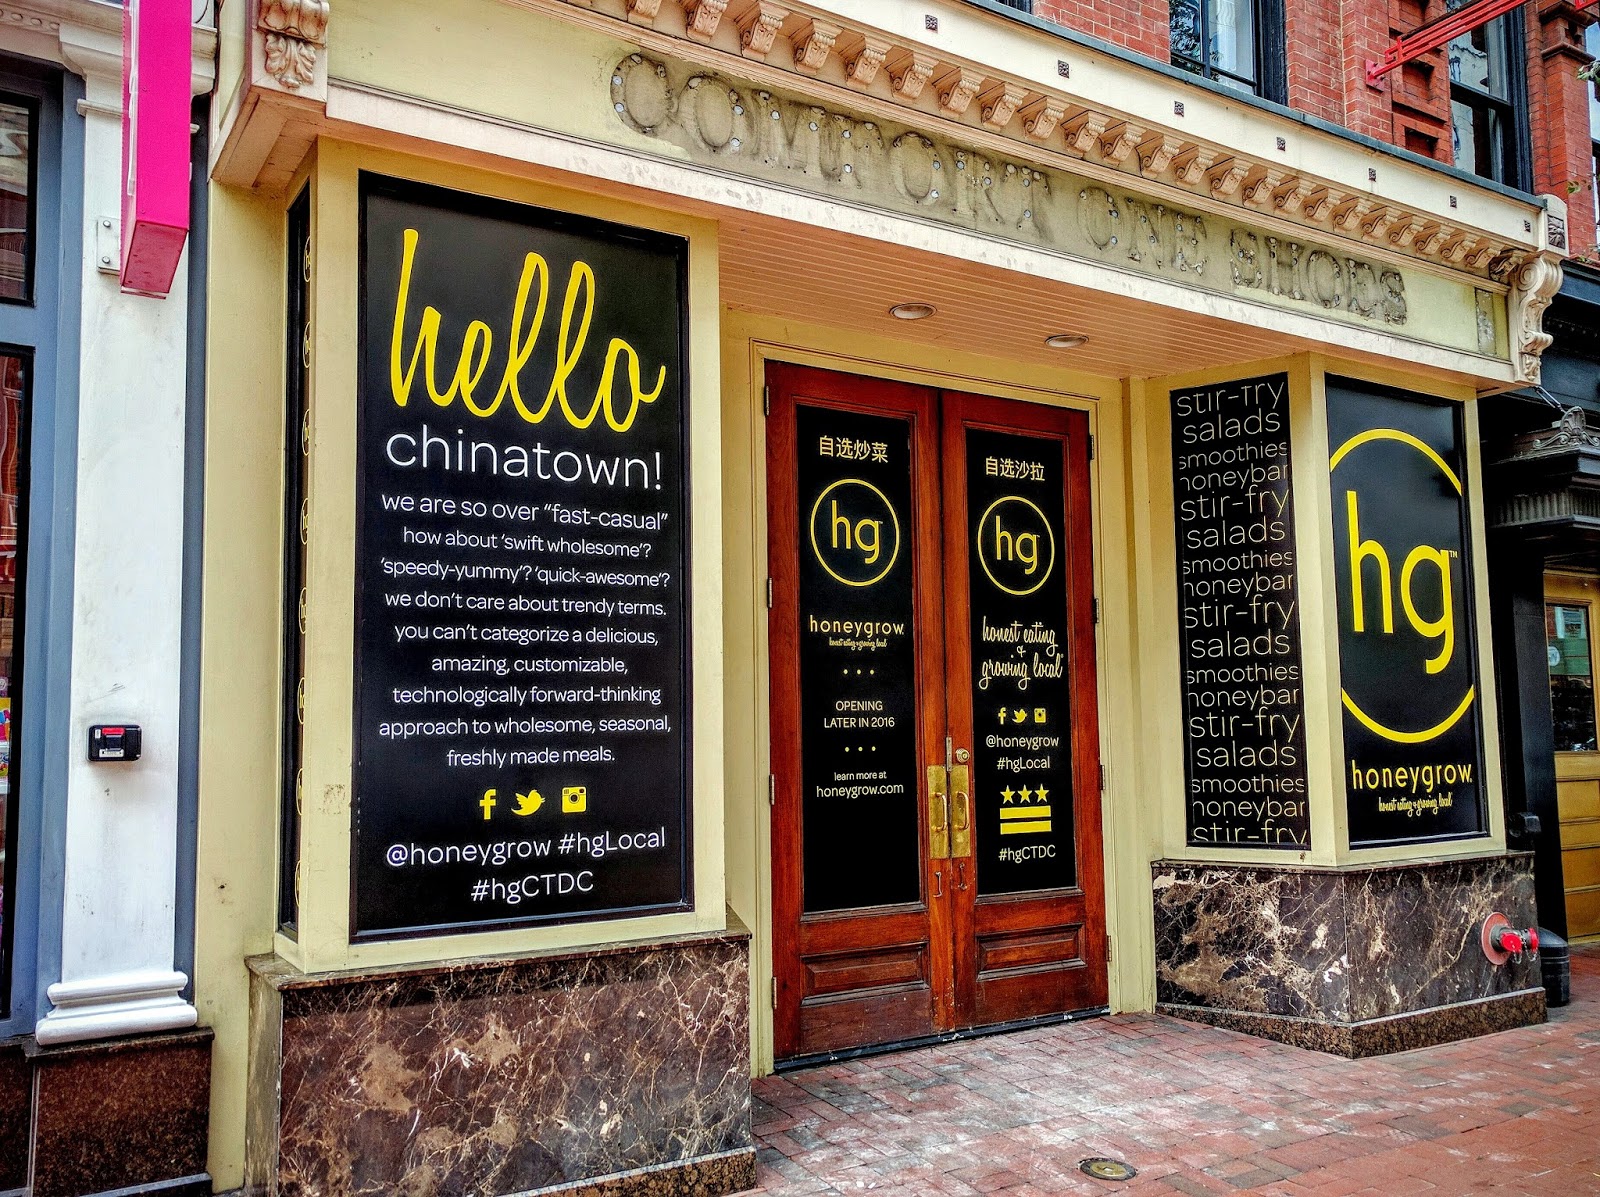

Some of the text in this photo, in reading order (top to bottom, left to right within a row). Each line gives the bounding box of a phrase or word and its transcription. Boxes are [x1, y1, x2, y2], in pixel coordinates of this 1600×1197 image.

[390, 228, 667, 433] hello
[1176, 382, 1284, 416] stir-fry
[1183, 408, 1281, 443] salads
[386, 425, 662, 490] chinatown!
[818, 435, 889, 464] 自选炒菜
[1179, 441, 1287, 470] smoothies
[985, 456, 1045, 482] 自选沙拉
[382, 494, 669, 530] we are so over "fast-casual"
[1180, 484, 1289, 521] stir-fry
[403, 527, 652, 557] how about 'swift wholesome'?
[831, 500, 881, 564] hg
[995, 515, 1038, 575] hg
[1187, 515, 1285, 549] salads
[381, 558, 670, 587] 'speedy-yummy'? 'quick-awesome'?
[1183, 550, 1293, 575] smoothies
[1346, 491, 1455, 674] hg
[385, 591, 667, 616] we don't care about trendy terms.
[1184, 594, 1295, 630] stir-fry
[394, 624, 659, 646] you can't categorize a delicious,
[810, 615, 903, 638] honeygrow
[982, 615, 1058, 657] honest eating
[1191, 628, 1290, 659] salads
[431, 656, 628, 675] amazing, customizable,
[978, 652, 1063, 690] growing local
[1187, 663, 1299, 684] smoothies
[393, 686, 661, 706] technologically forward-thinking
[835, 700, 883, 711] OPENING
[379, 715, 671, 739] approach to wholesome, seasonal,
[824, 717, 895, 728] LATER IN 2016
[1189, 706, 1300, 743] stir-fry
[985, 734, 1059, 750] @honeygrow
[1196, 740, 1296, 767] salads
[447, 746, 615, 768] freshly made meals.
[997, 756, 1050, 773] #hgLocal
[834, 771, 887, 781] learn more at
[1192, 774, 1304, 793] smoothies
[1352, 759, 1472, 794] honeygrow
[816, 784, 904, 799] honeygrow.com
[1194, 818, 1307, 845] stir-fry
[386, 827, 665, 867] @honeygrow #hgLocal
[998, 845, 1056, 863] #hgCTDC
[471, 871, 594, 904] #hgCTDC
